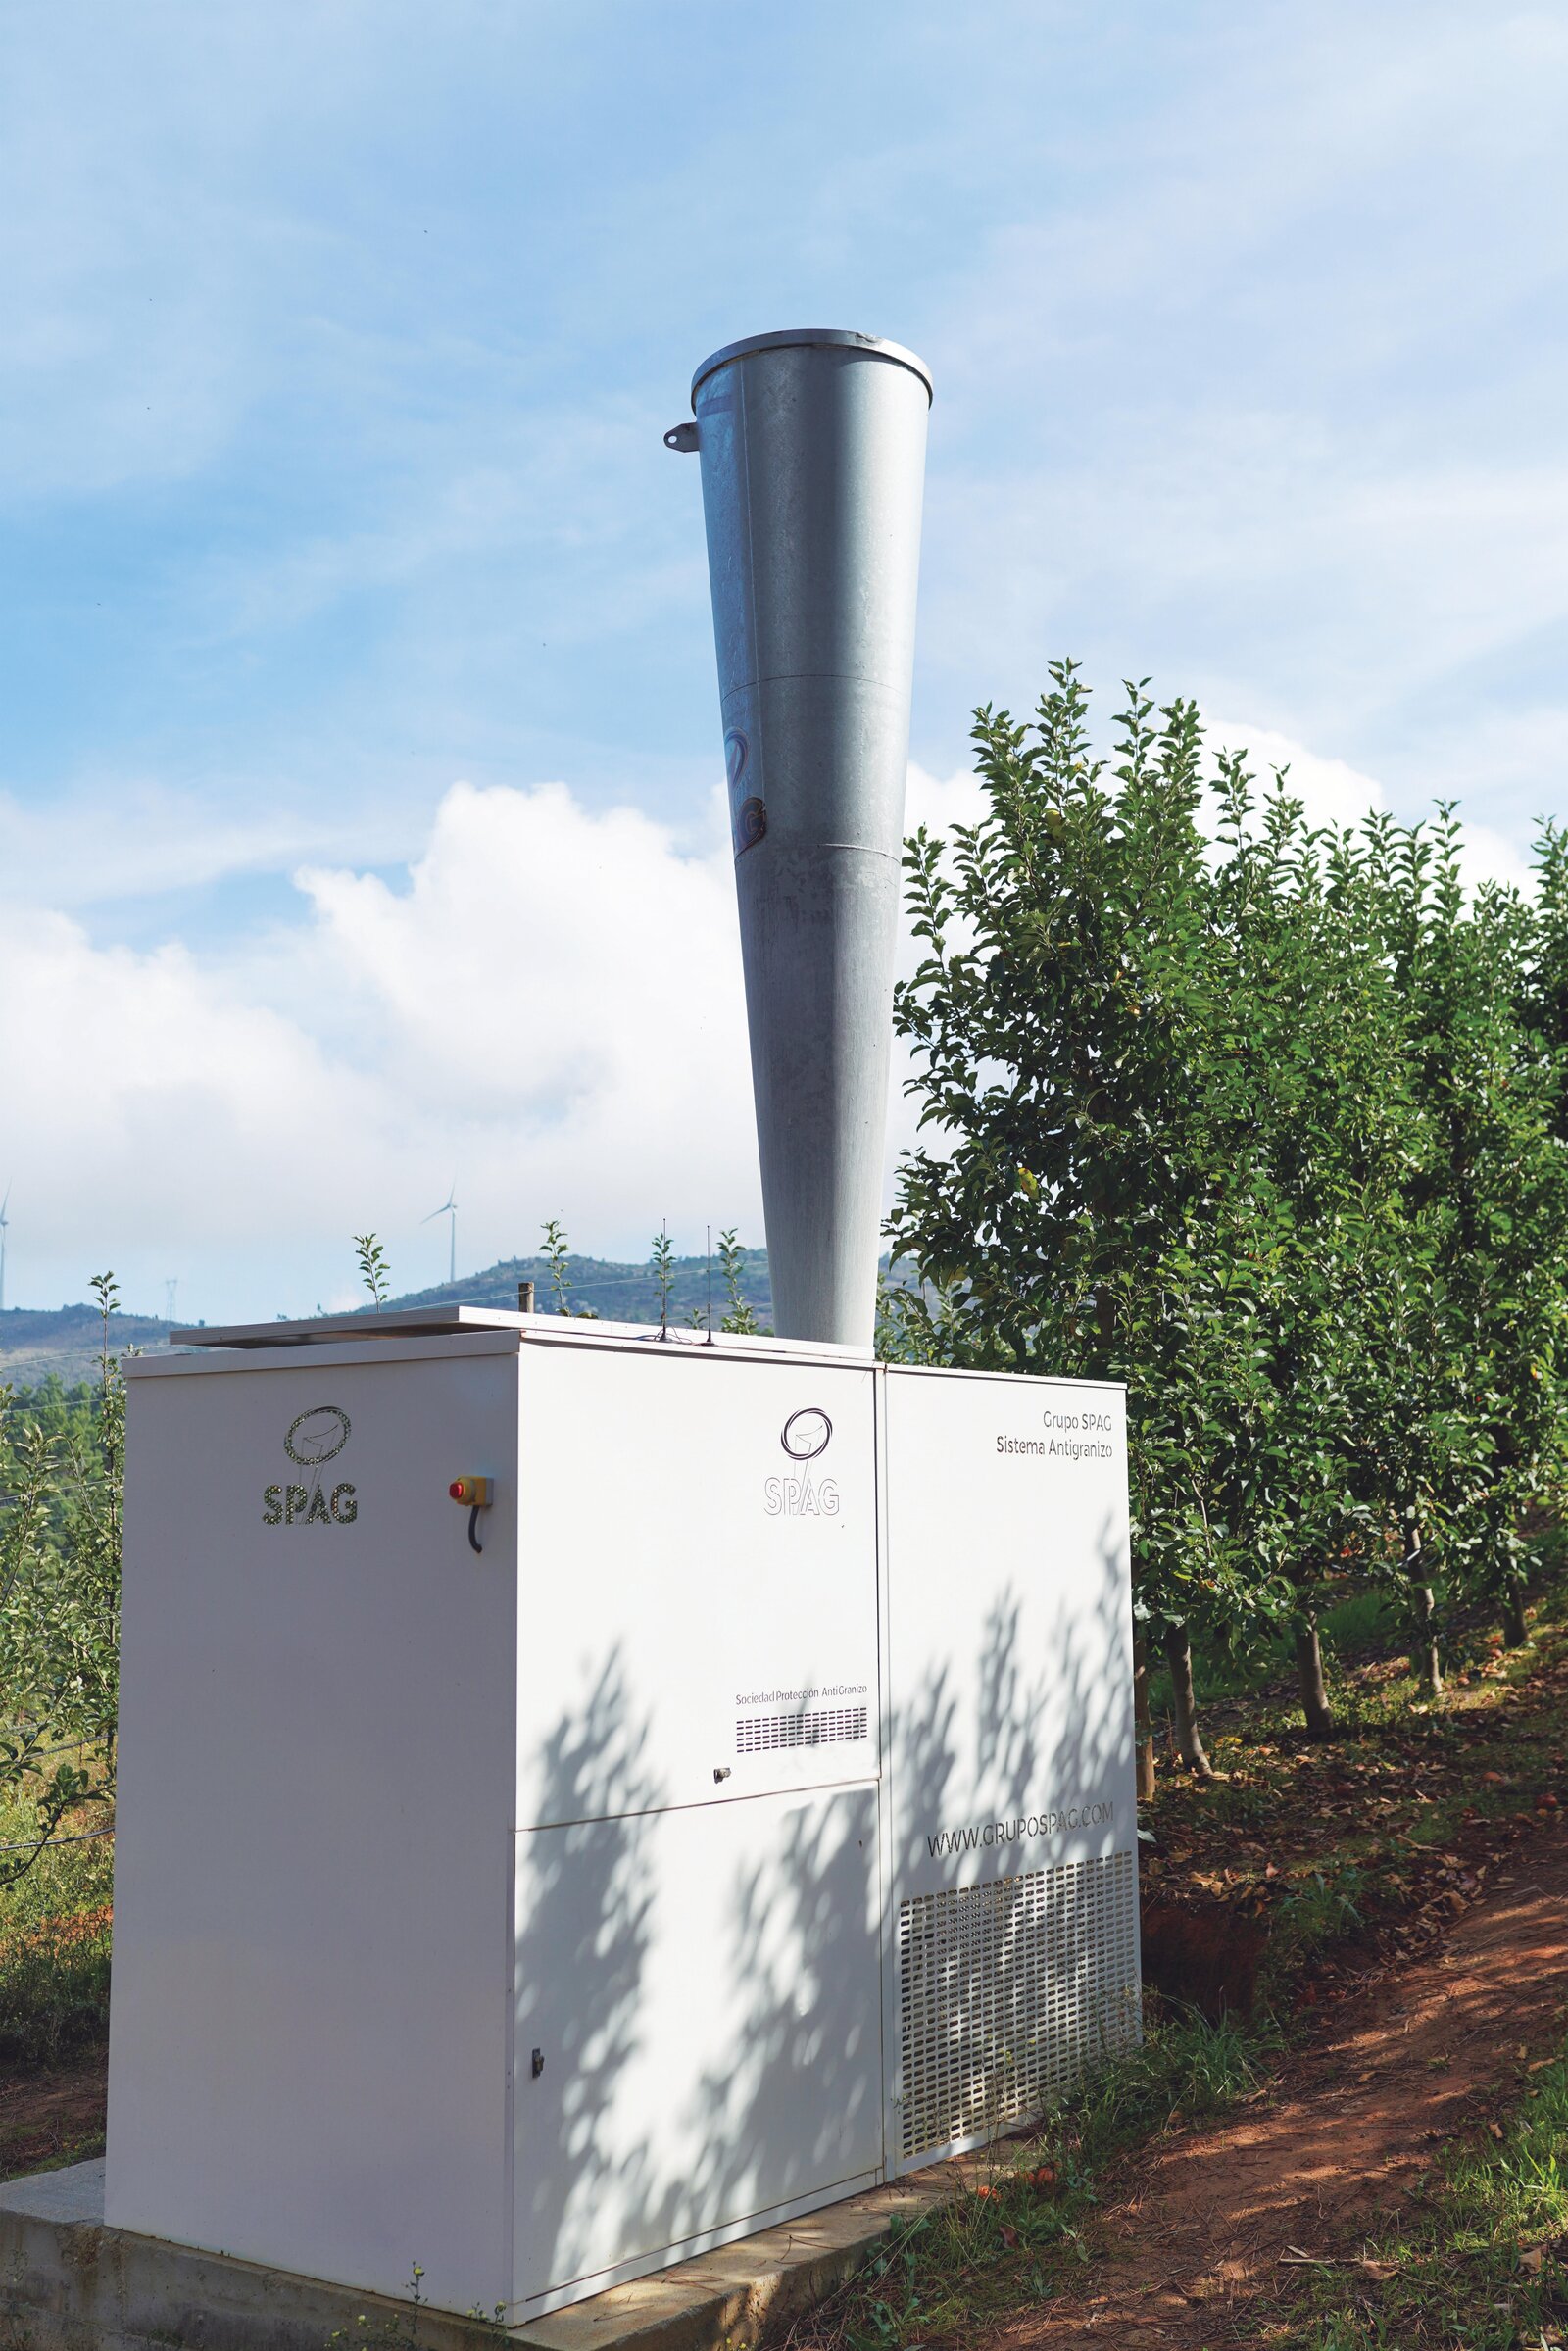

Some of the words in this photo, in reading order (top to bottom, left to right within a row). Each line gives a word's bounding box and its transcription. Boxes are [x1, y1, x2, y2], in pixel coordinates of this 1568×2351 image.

[1043, 1410, 1079, 1433] Grupo
[1081, 1413, 1112, 1431] SPAG
[996, 1435, 1046, 1455] Sistema
[1048, 1438, 1113, 1460] Antigranizo
[262, 1483, 358, 1525] SPAG
[763, 1476, 840, 1516] SPAG
[736, 1690, 775, 1705] Sociedad
[775, 1687, 819, 1701] Protección
[821, 1683, 868, 1697] AntiGranizo
[927, 1801, 1114, 1858] WWW.GRUPOSPAG.COM
